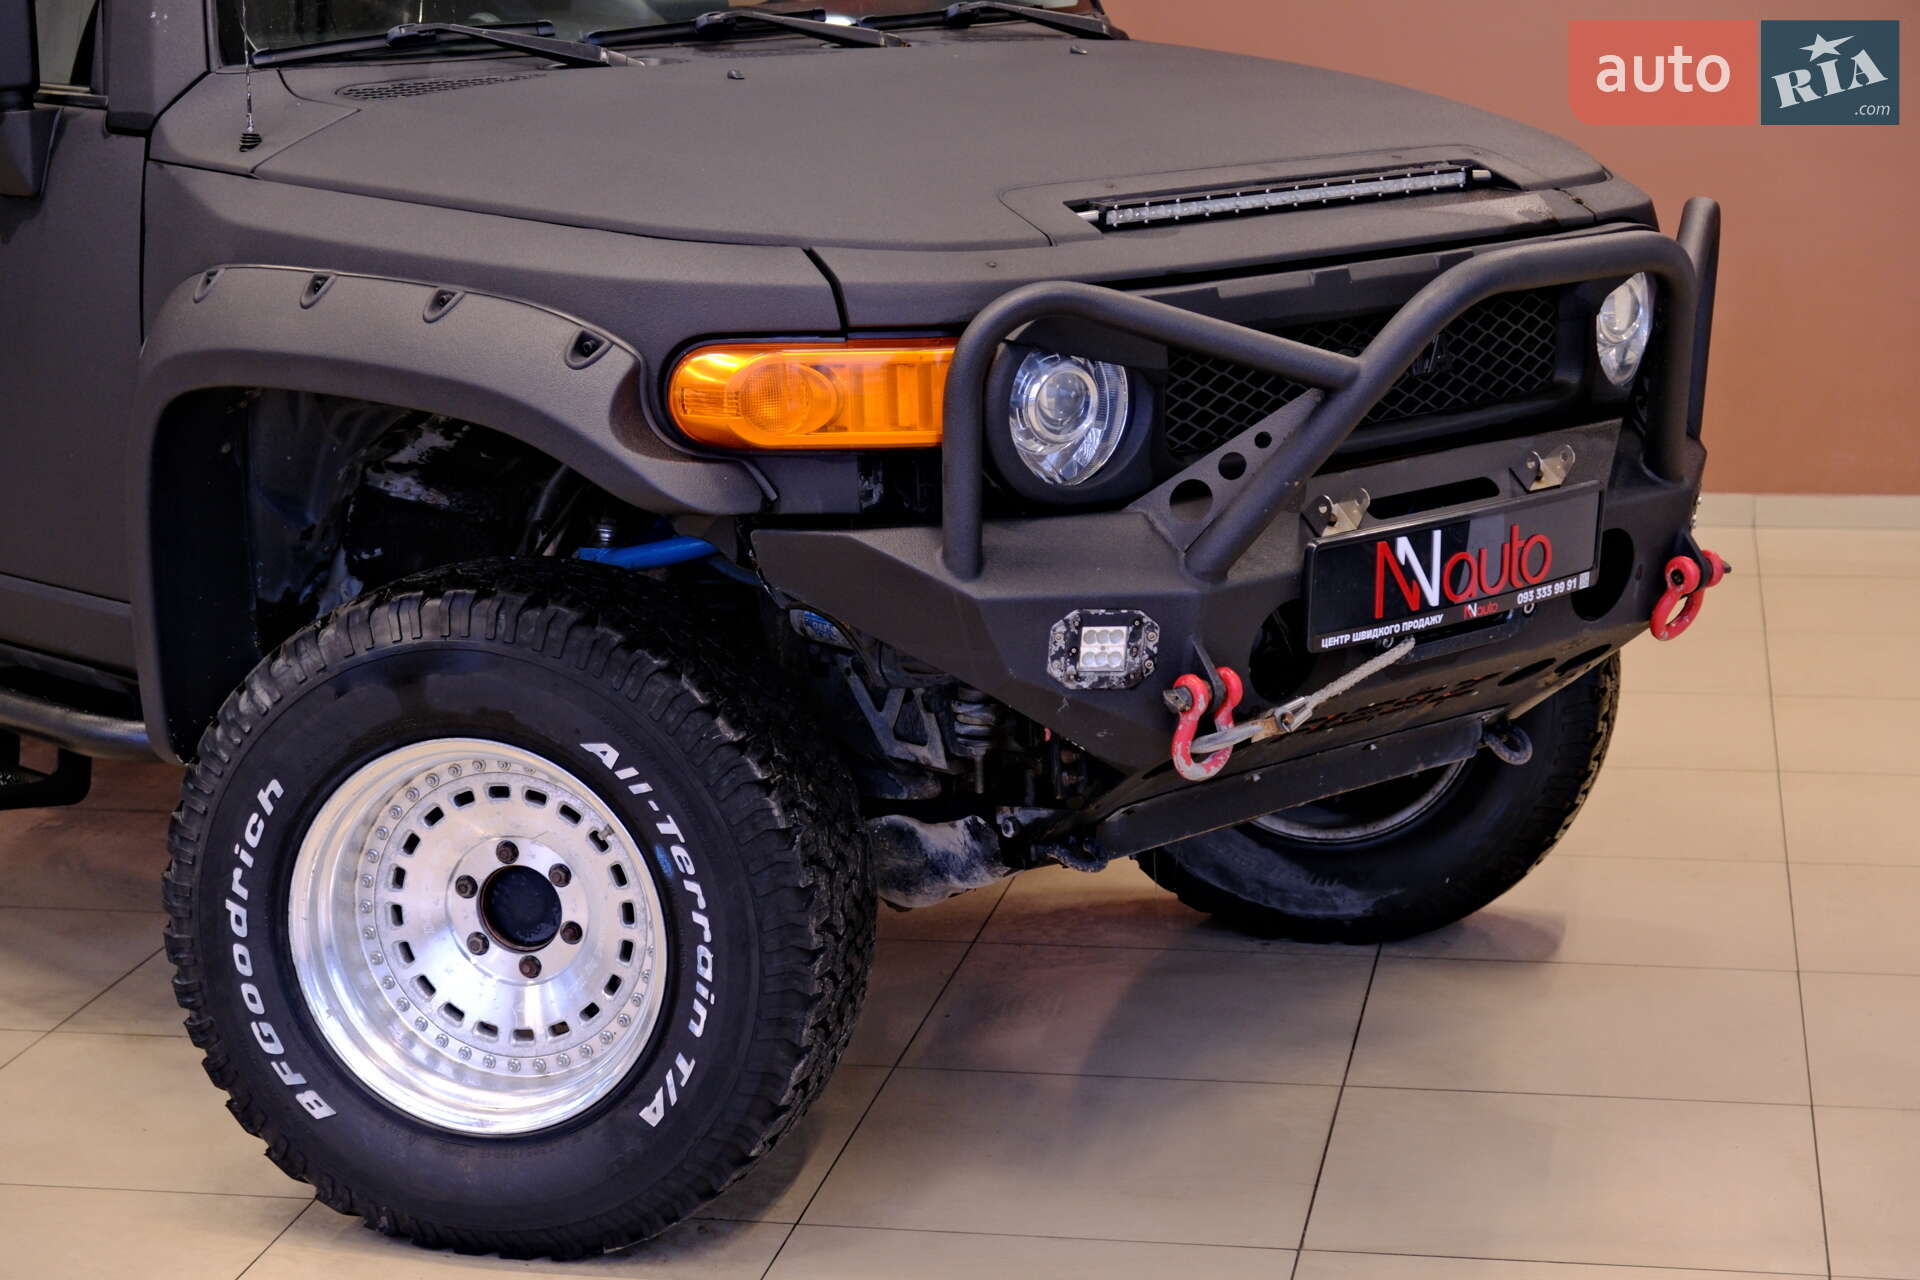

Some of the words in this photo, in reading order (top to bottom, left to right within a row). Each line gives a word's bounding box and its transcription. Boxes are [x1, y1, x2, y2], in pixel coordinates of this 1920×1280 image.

[1516, 590, 1535, 605] 093
[1535, 585, 1553, 600] 333
[1553, 581, 1566, 594] 99
[1566, 577, 1578, 591] 91
[1321, 634, 1351, 649] ЦЕНТР
[1352, 624, 1401, 643] ШВИДКОГО
[1401, 613, 1444, 633] ПРОДАЖУ
[579, 741, 716, 1038] All-Terrain
[225, 778, 337, 1120] BFGoodrich
[638, 1051, 697, 1128] T/A
